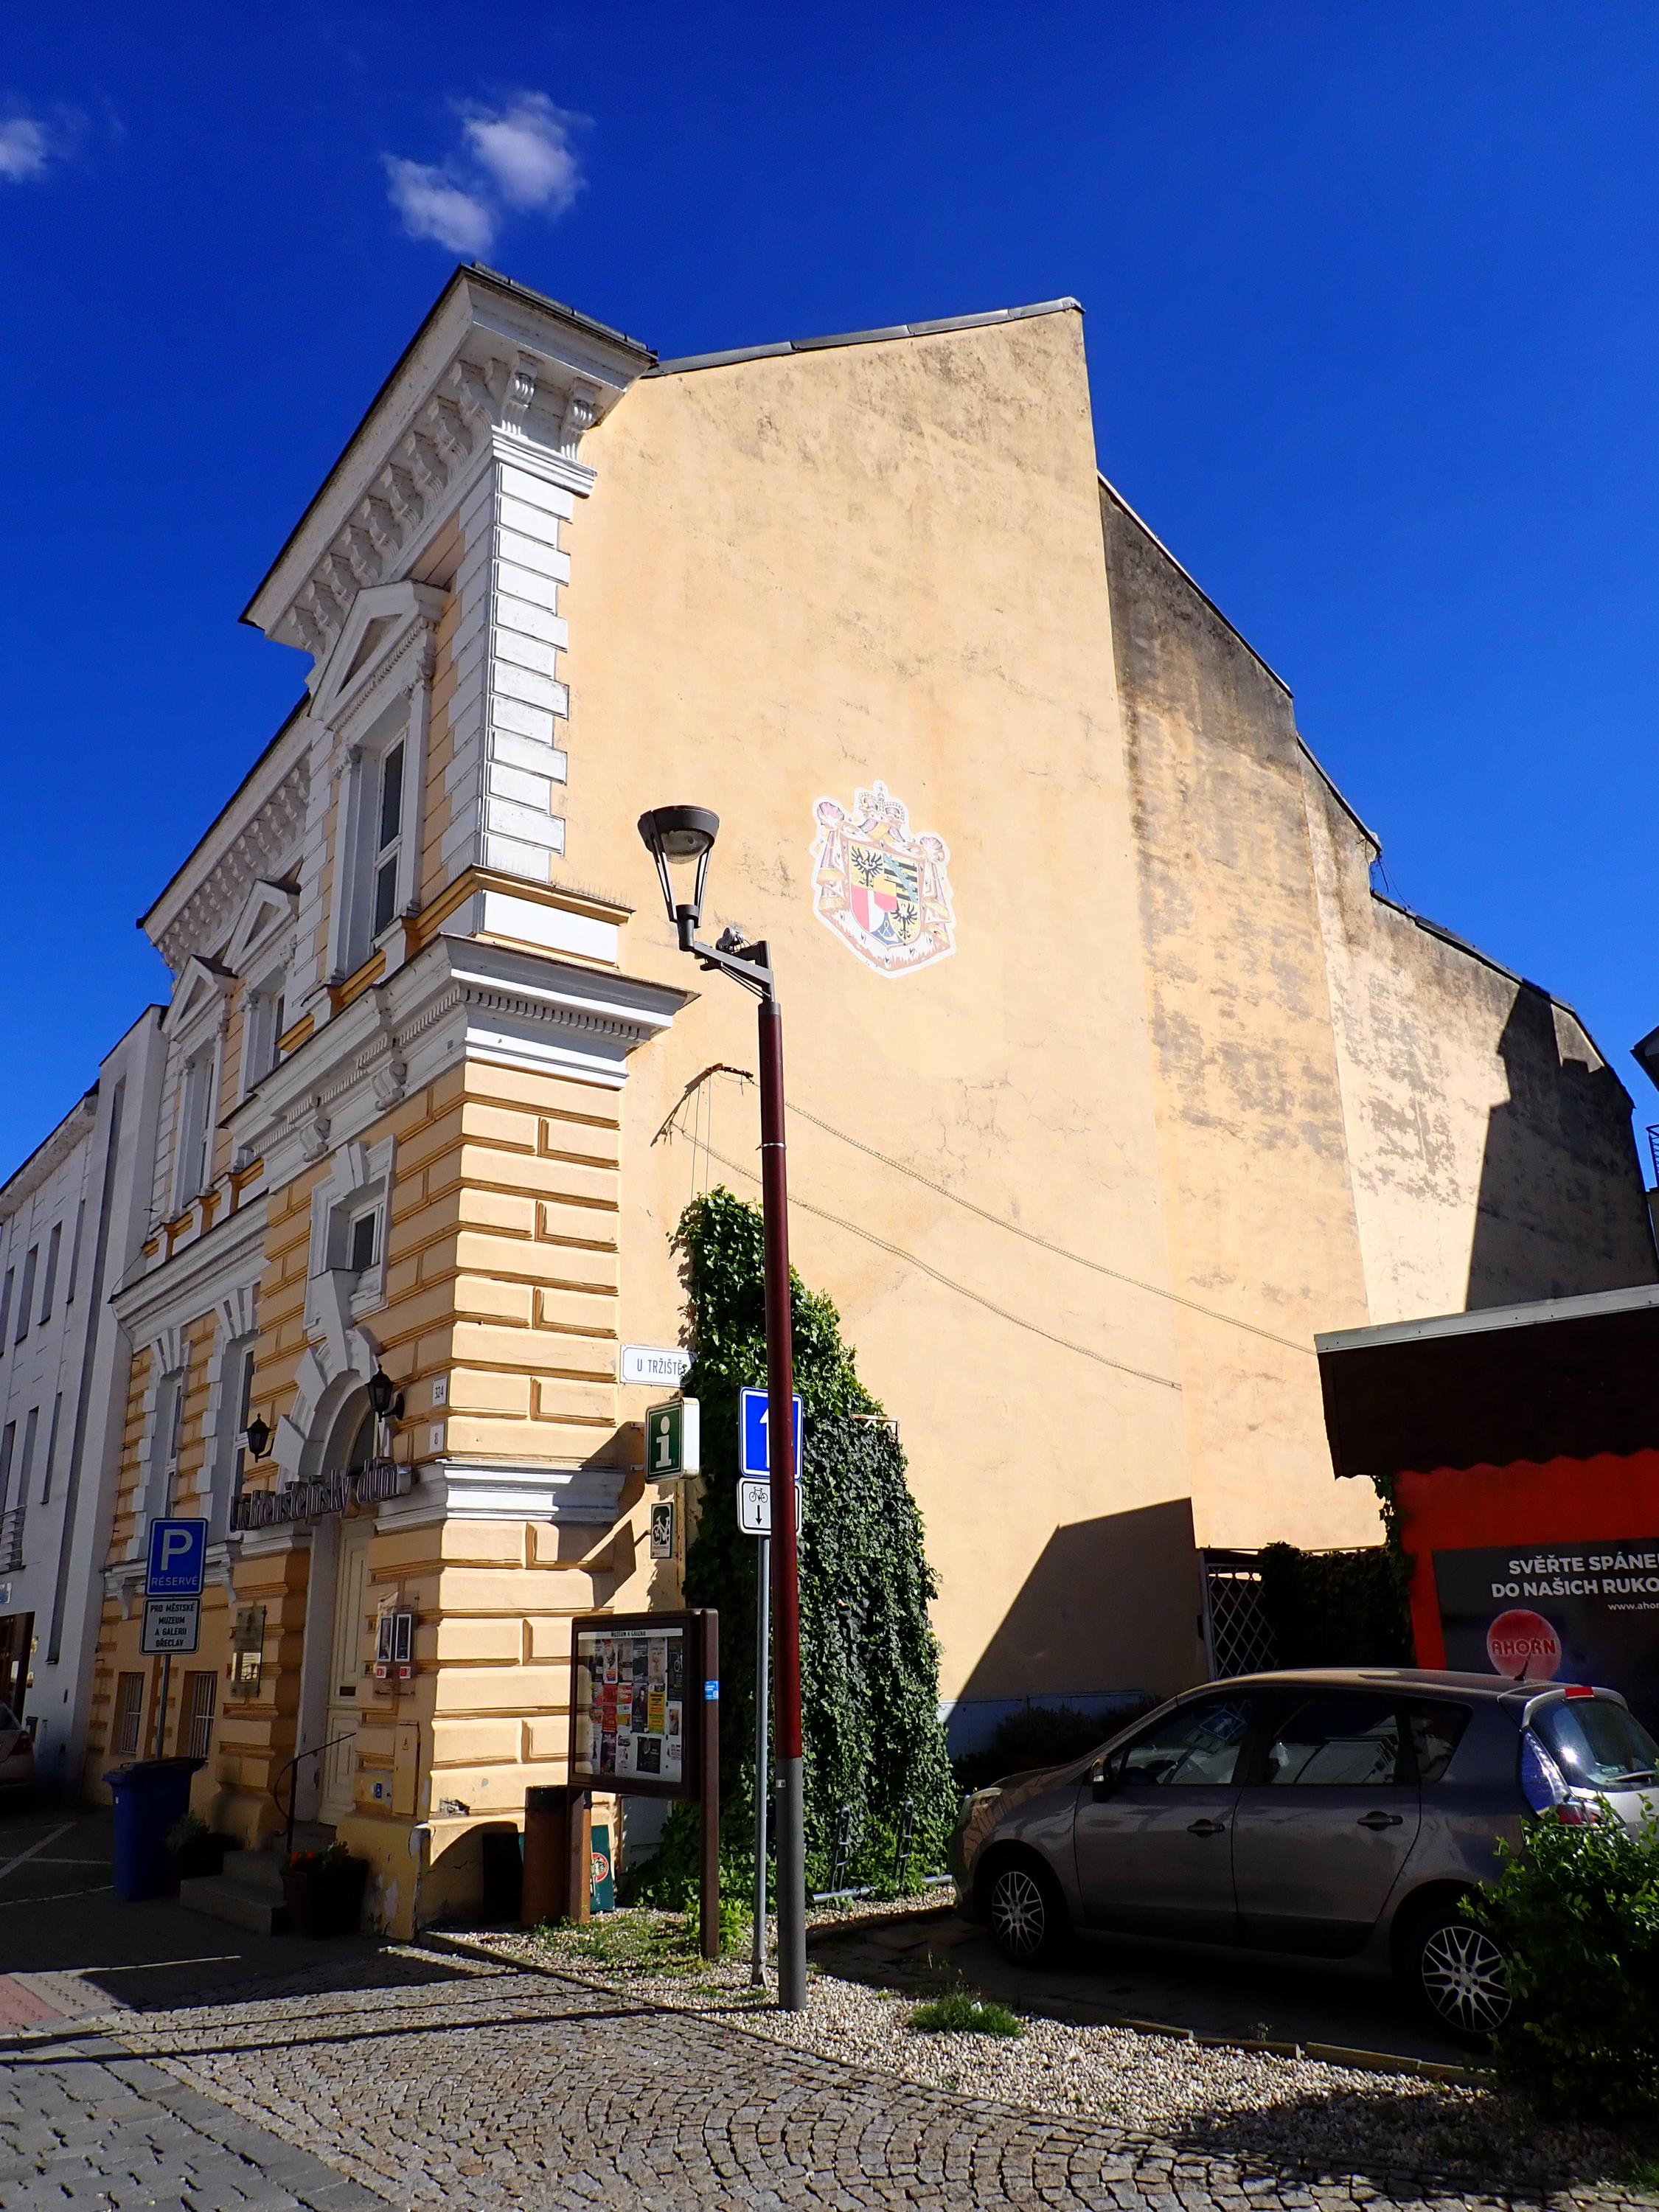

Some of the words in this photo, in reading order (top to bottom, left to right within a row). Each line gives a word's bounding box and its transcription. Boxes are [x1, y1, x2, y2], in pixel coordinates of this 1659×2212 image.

[636, 1357, 643, 1372] U
[647, 1357, 683, 1376] TRŽIŠTĚ
[435, 1386, 443, 1399] 324
[434, 1433, 438, 1444] 8
[357, 1458, 403, 1504] dům
[160, 1528, 193, 1571] P
[1509, 1554, 1585, 1575] SVĚŘTE
[1588, 1551, 1659, 1571] SPÁNE
[151, 1574, 199, 1586] RÉSERVÉ
[1491, 1582, 1520, 1598] DO
[1523, 1576, 1599, 1597] NAŠICH
[150, 1604, 163, 1613] PRO
[166, 1602, 195, 1613] MĚSTSKÉ
[159, 1616, 185, 1624] MUZEUM
[162, 1627, 187, 1635] GALERII
[156, 1638, 184, 1647] BŘECLAV
[1491, 1639, 1556, 1655] AHORN
